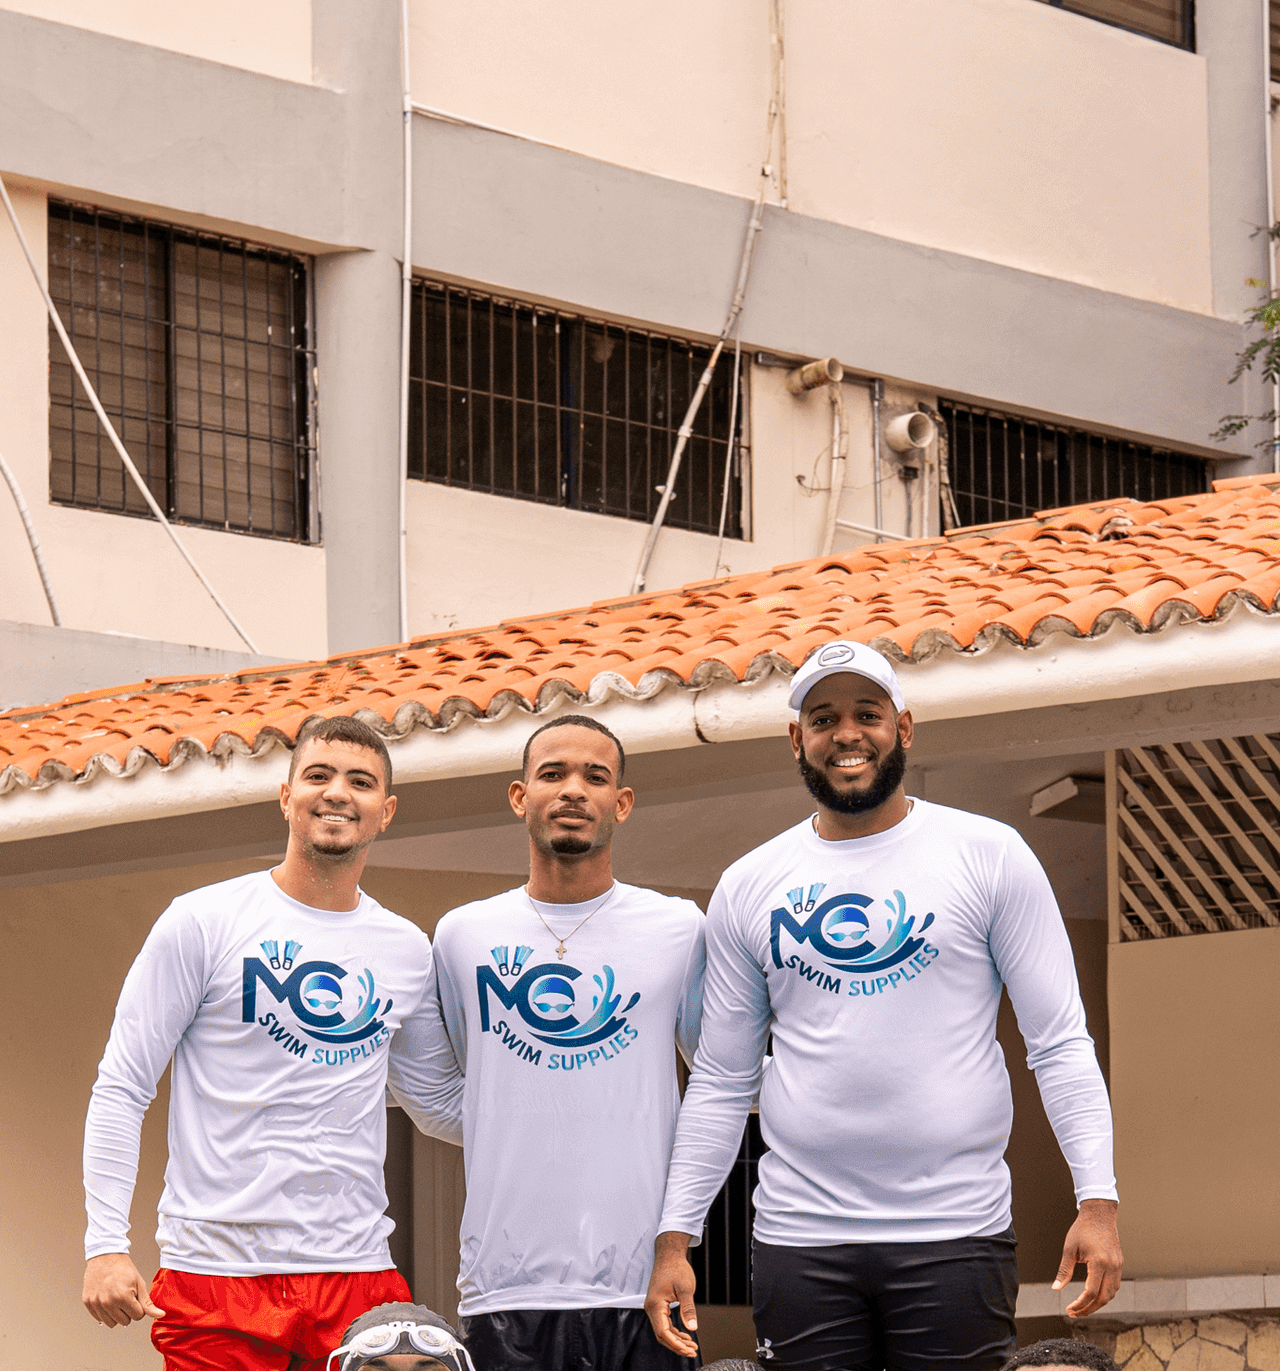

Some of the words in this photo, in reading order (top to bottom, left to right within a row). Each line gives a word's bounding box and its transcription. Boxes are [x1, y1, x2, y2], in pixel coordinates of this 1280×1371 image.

[785, 954, 842, 995] SWIM
[848, 943, 940, 997] SUPPLIES
[258, 1012, 309, 1059] SWIM
[311, 1026, 391, 1066] SUPPLIES
[492, 1020, 543, 1066] SWIM
[547, 1024, 639, 1071] SUPPLIES
